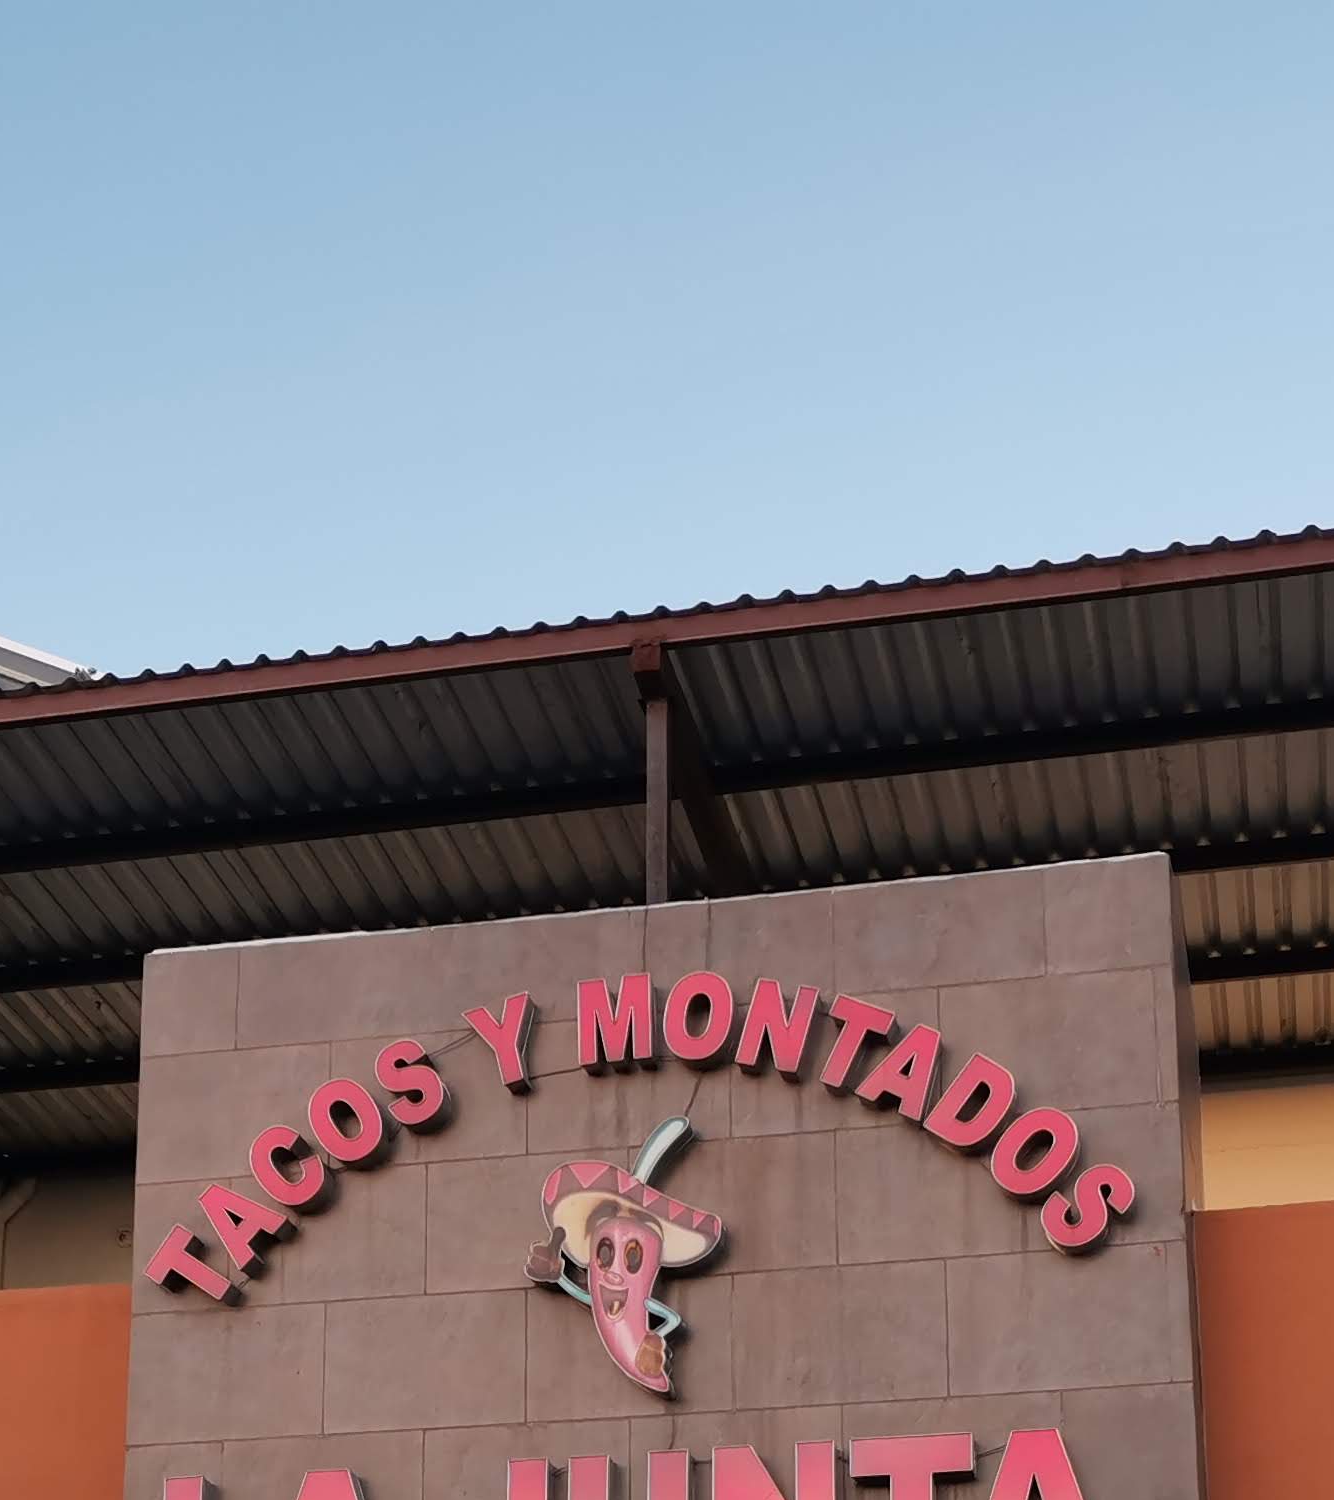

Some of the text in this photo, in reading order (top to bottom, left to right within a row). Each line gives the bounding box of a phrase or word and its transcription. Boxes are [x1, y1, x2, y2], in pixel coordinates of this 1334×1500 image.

[143, 970, 1135, 1305] TACOS Y MONTADOS
